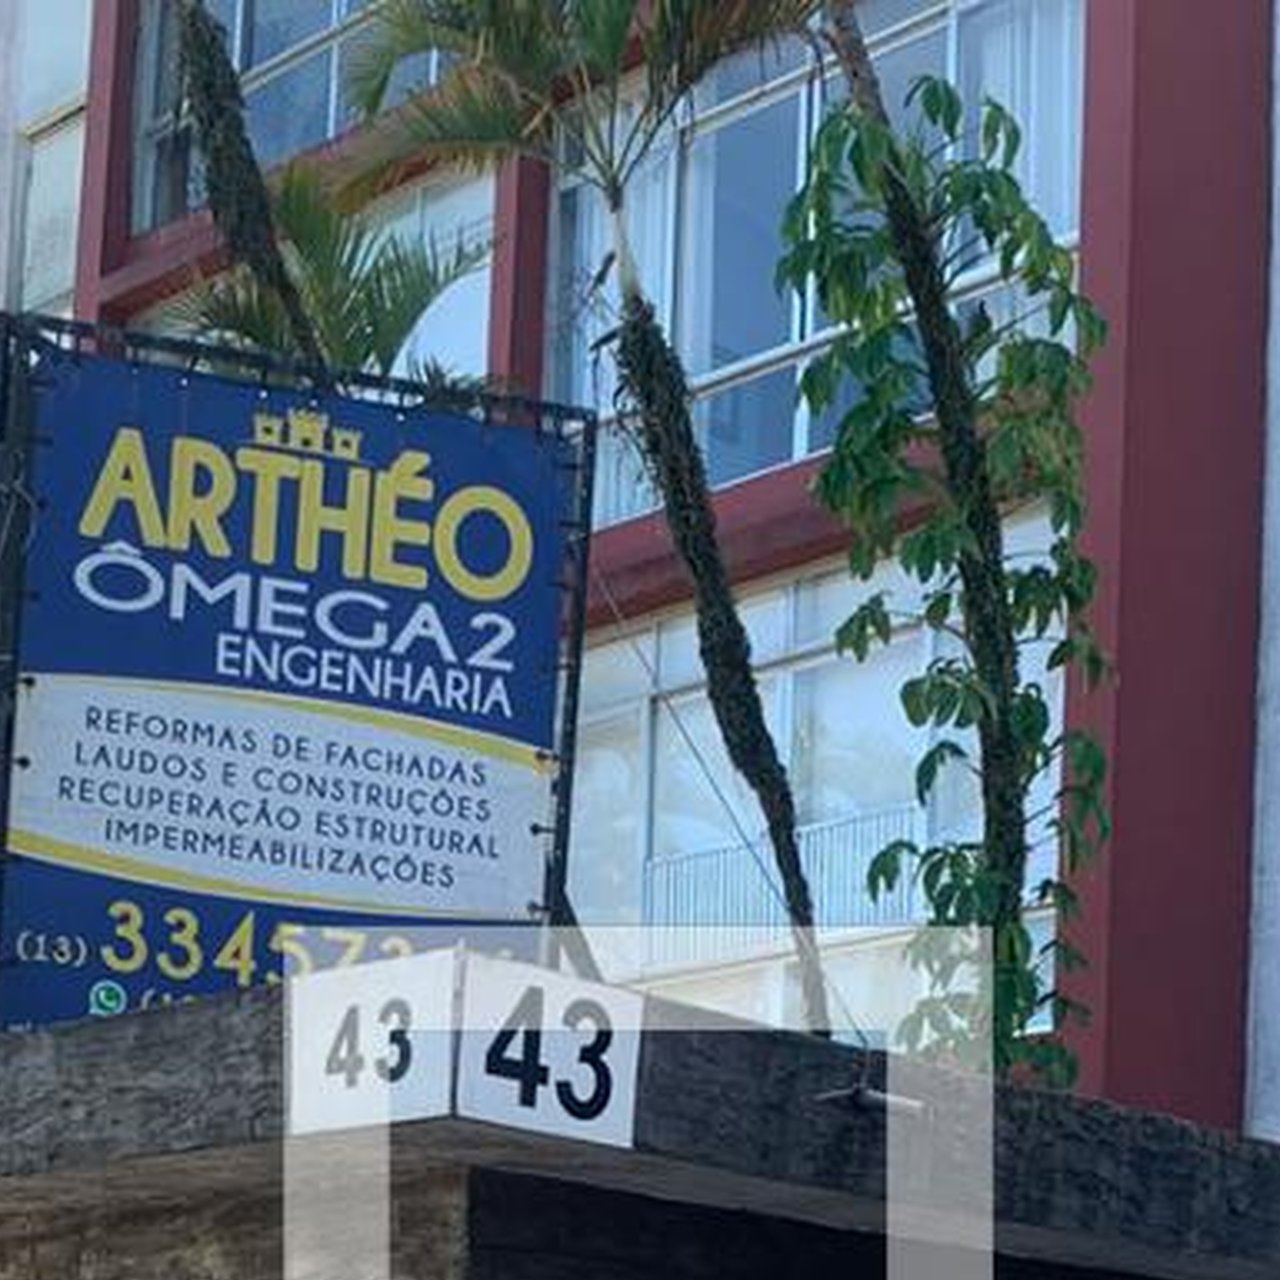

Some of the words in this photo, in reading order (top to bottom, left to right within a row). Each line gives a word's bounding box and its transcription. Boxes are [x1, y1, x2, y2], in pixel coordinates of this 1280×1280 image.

[78, 428, 535, 600] ARTHÉO
[216, 633, 513, 718] ENGENHARIA
[75, 740, 207, 782] LAUDOS
[222, 762, 238, 787] E
[252, 767, 492, 822] CONSTRUÇÕES
[86, 706, 258, 754] REFORMAS
[273, 733, 311, 762] DE
[325, 741, 486, 787] FACHADAS
[57, 776, 301, 831] RECUPERAÇÃO
[315, 811, 500, 858] ESTRUTURAL
[104, 818, 455, 888] IMPERMEABILIZAÇÕES
[16, 930, 88, 968] (13)
[325, 997, 413, 1088] 43
[484, 985, 614, 1121] 43
